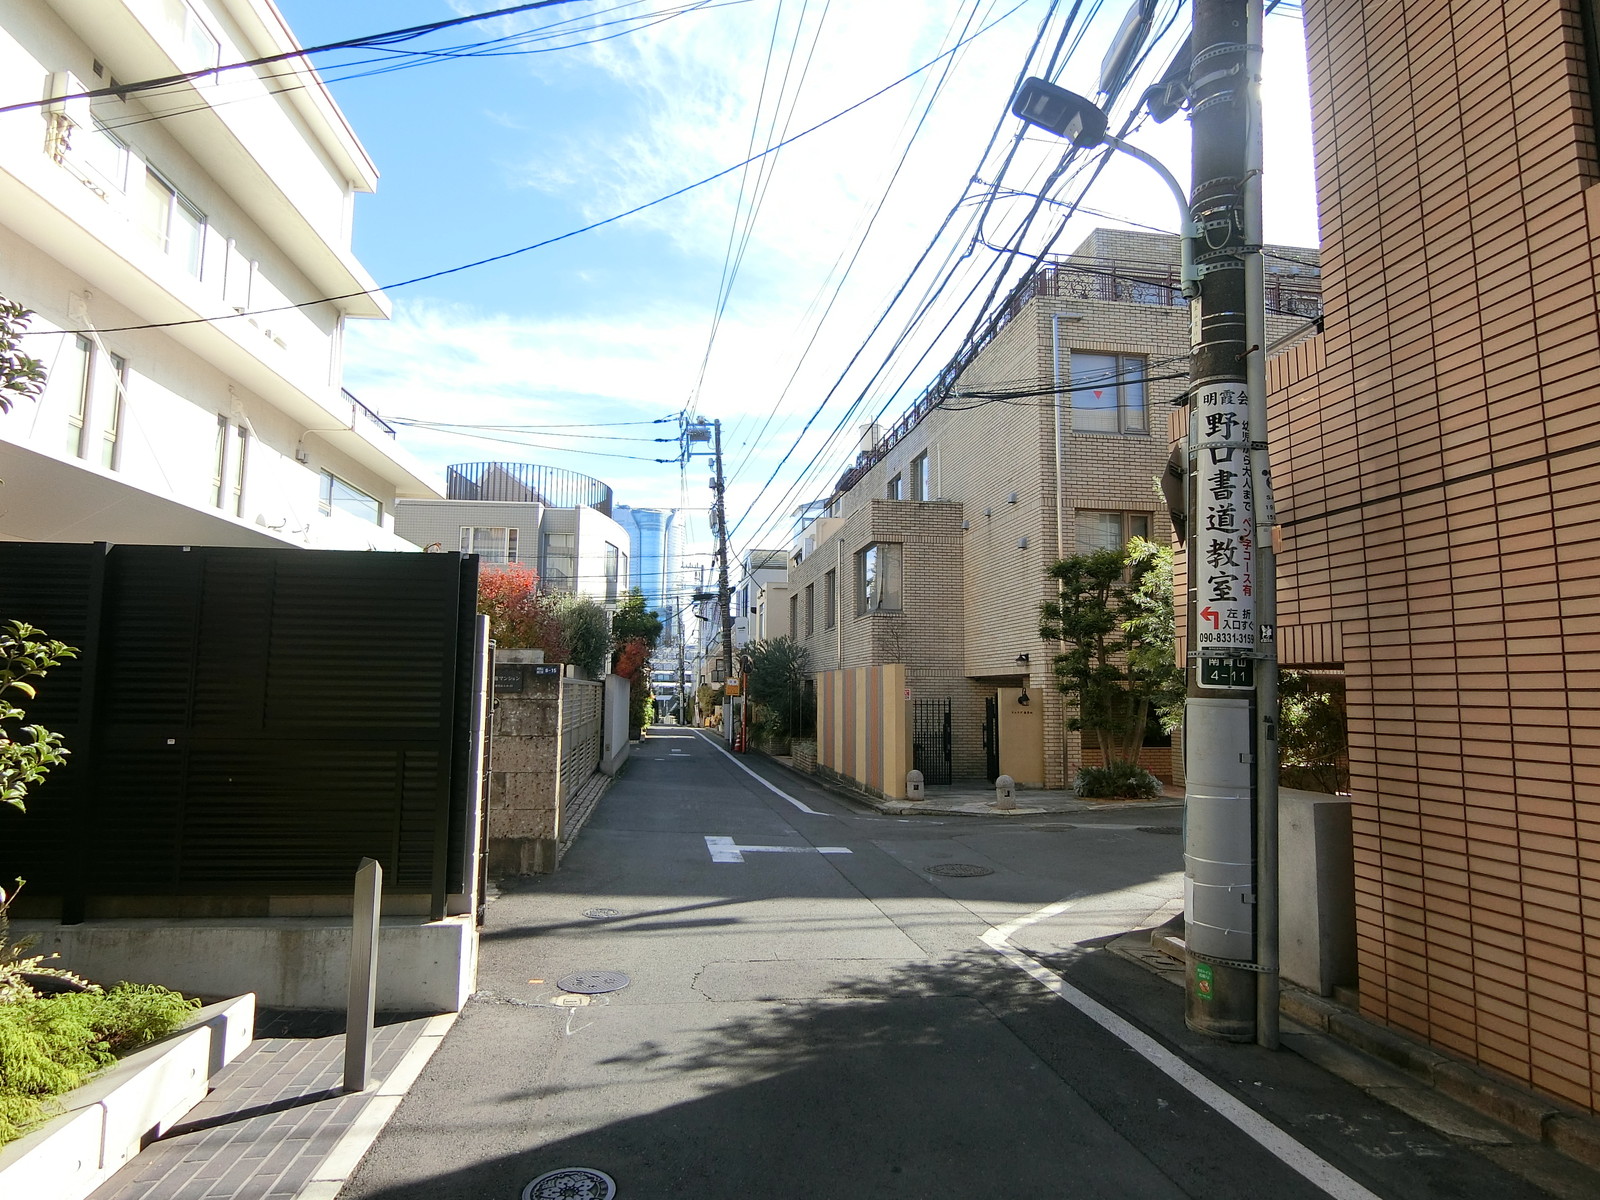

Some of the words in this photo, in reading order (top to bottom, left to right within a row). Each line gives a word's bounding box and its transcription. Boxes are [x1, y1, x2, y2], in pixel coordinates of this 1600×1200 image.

[1203, 389, 1249, 407] 明霞会
[1241, 420, 1252, 512] 幼児から大人まで
[1205, 411, 1240, 602] 野口書道教室
[1241, 518, 1253, 597] ペン字コース有
[1226, 608, 1251, 620] 左折
[1222, 620, 1254, 631] 入口すぐ
[1199, 632, 1255, 645] 090-8331-3159
[1210, 670, 1246, 682] 4-11
